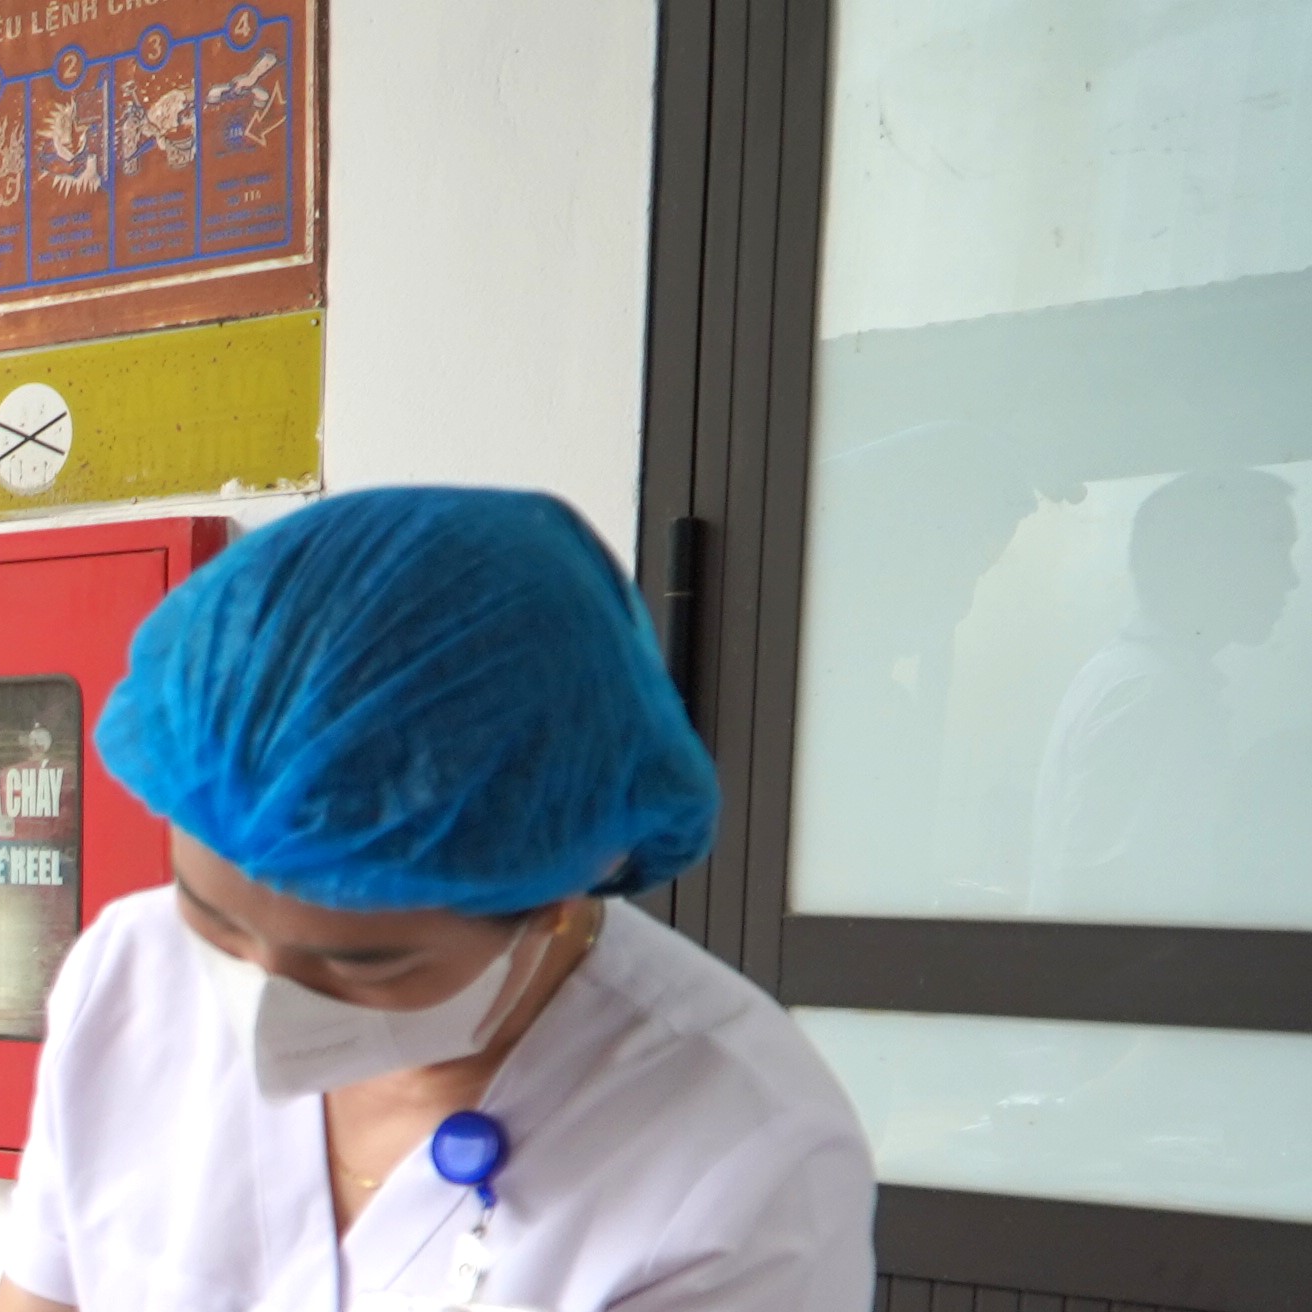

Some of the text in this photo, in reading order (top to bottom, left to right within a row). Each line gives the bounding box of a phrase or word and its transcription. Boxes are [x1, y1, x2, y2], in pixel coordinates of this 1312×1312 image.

[31, 1, 98, 36] LỆNH
[234, 11, 251, 37] 4
[147, 34, 162, 60] 3
[63, 56, 77, 79] 2
[6, 758, 64, 818] CHÁY
[10, 849, 63, 885] REEL
